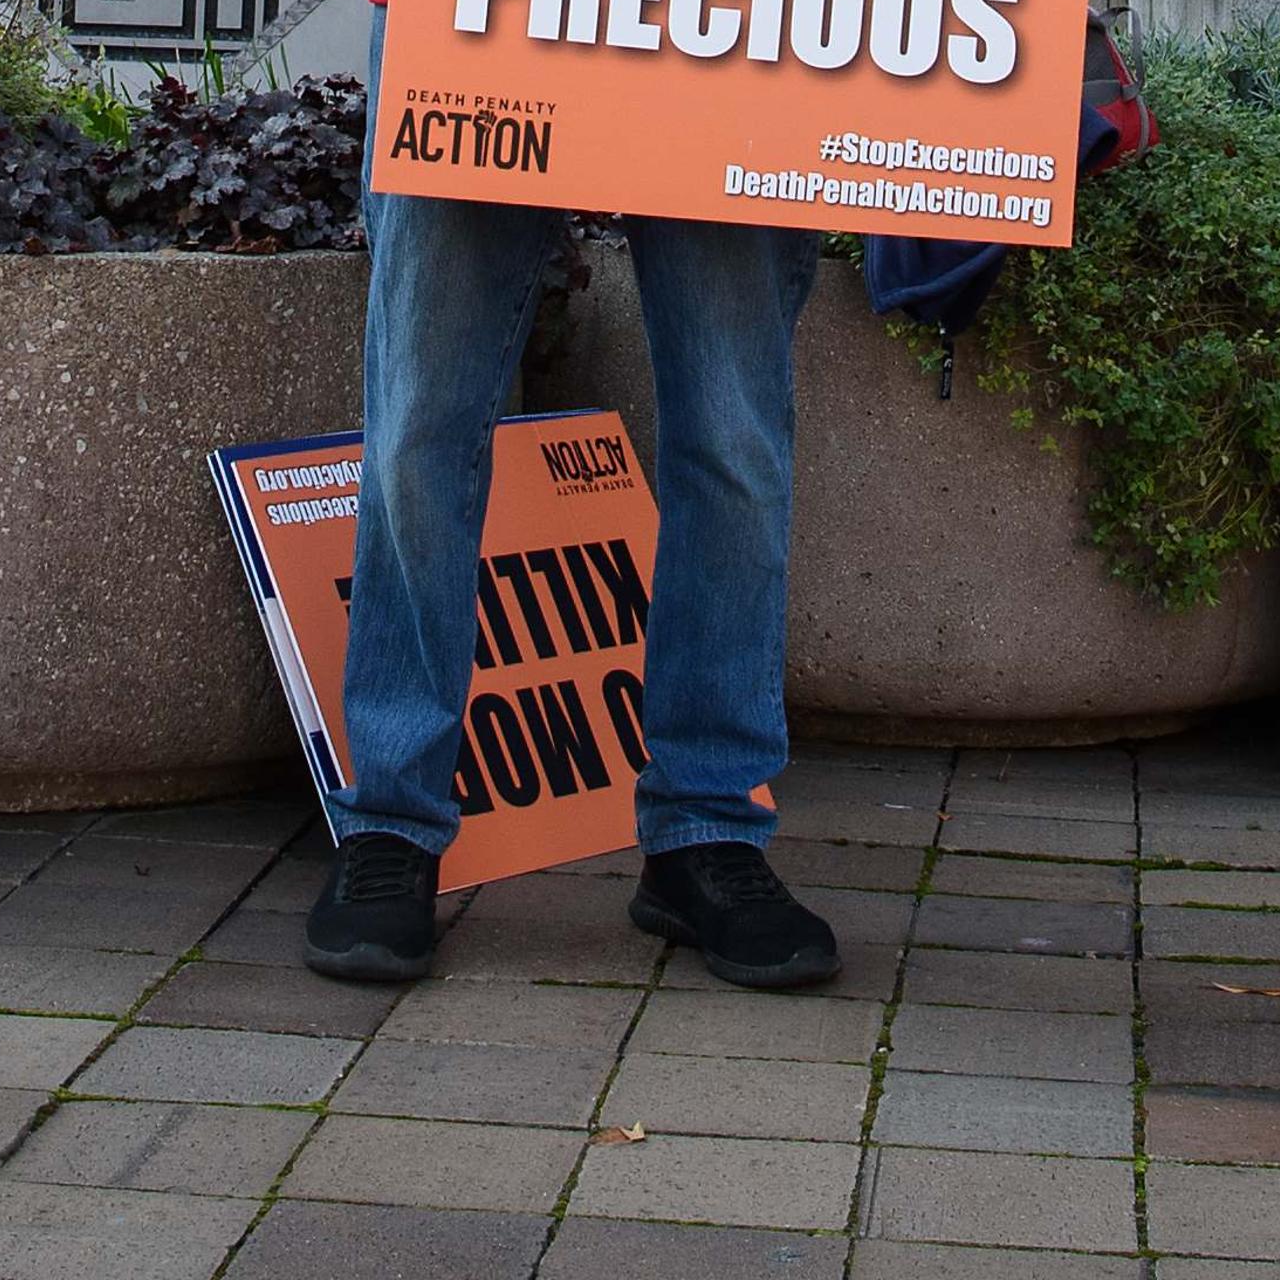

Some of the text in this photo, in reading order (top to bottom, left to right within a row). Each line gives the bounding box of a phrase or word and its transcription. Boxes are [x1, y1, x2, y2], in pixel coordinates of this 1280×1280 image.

[407, 89, 557, 117] DEATH PENALTY
[390, 107, 551, 173] ACTION
[819, 133, 1054, 181] #StopExecutions
[725, 165, 1052, 227] DeathPenaltyAction.org
[540, 435, 629, 484] ACTION
